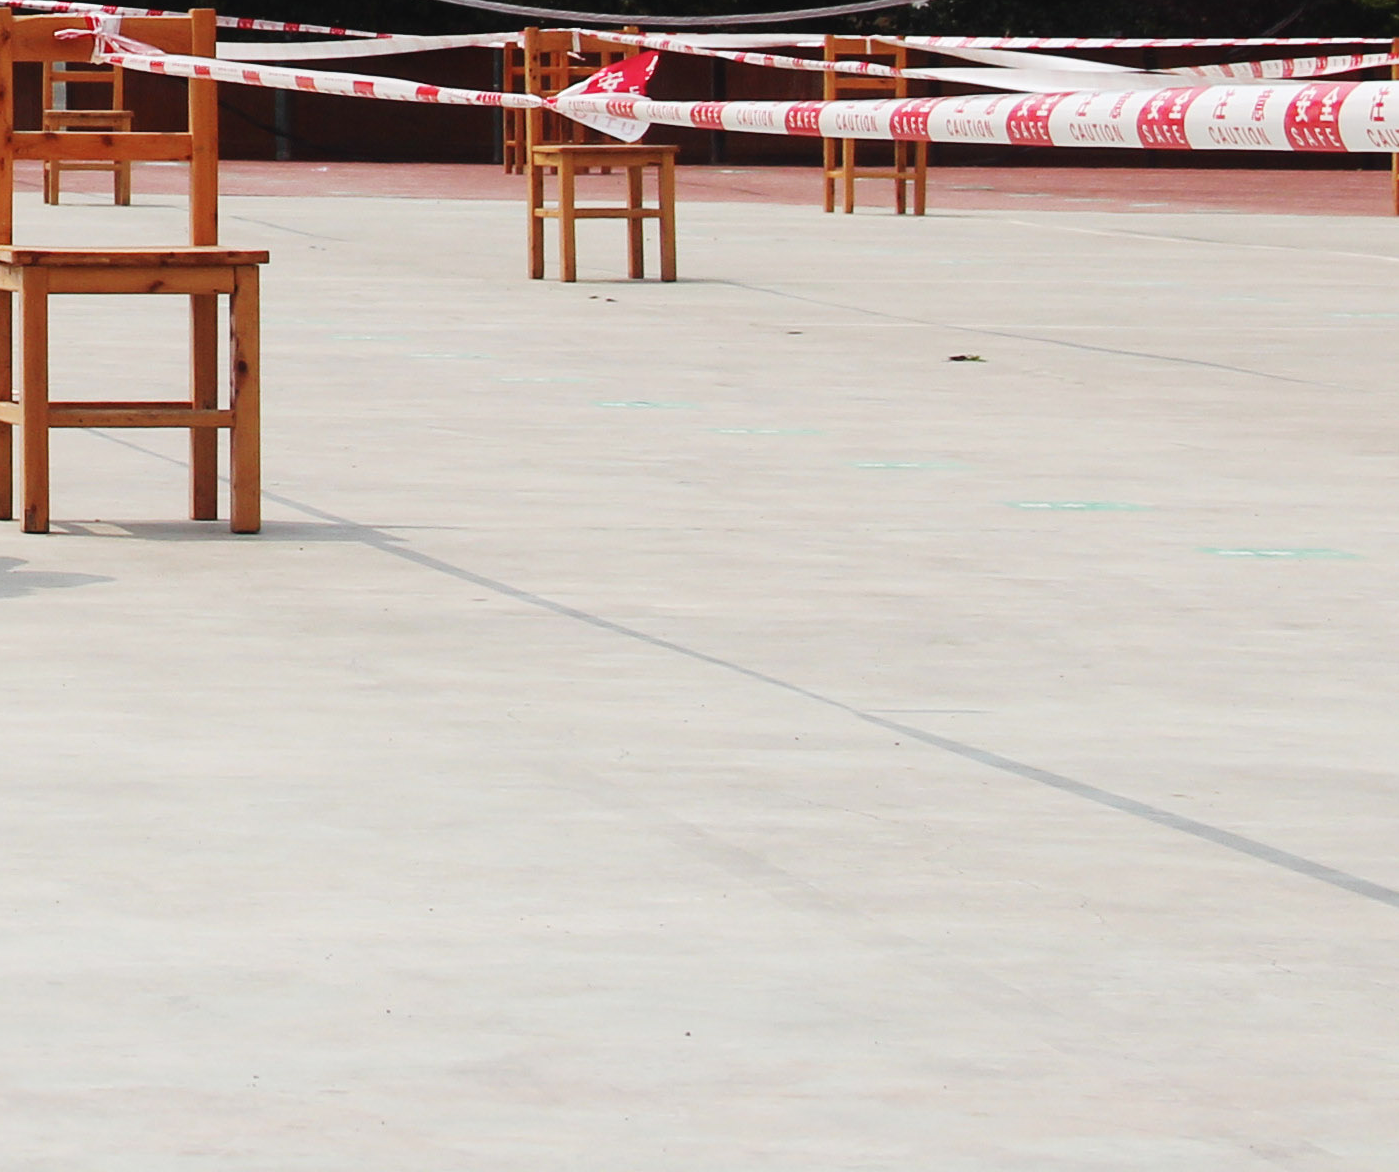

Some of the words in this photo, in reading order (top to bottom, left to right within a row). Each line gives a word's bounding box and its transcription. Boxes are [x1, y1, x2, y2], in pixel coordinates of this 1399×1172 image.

[1294, 86, 1340, 122] 安全
[691, 105, 721, 124] SAFE
[735, 108, 774, 127] CAUTION
[788, 110, 818, 129] SAFE
[835, 113, 878, 133] CAUTION
[893, 115, 927, 135] SAFE
[946, 118, 995, 138] CAUTION
[1010, 120, 1049, 140] SAFE
[1069, 122, 1125, 142] CAUTION
[1141, 124, 1186, 144] SAFE
[1207, 126, 1273, 146] CAUTION
[1290, 127, 1341, 147] SAFE
